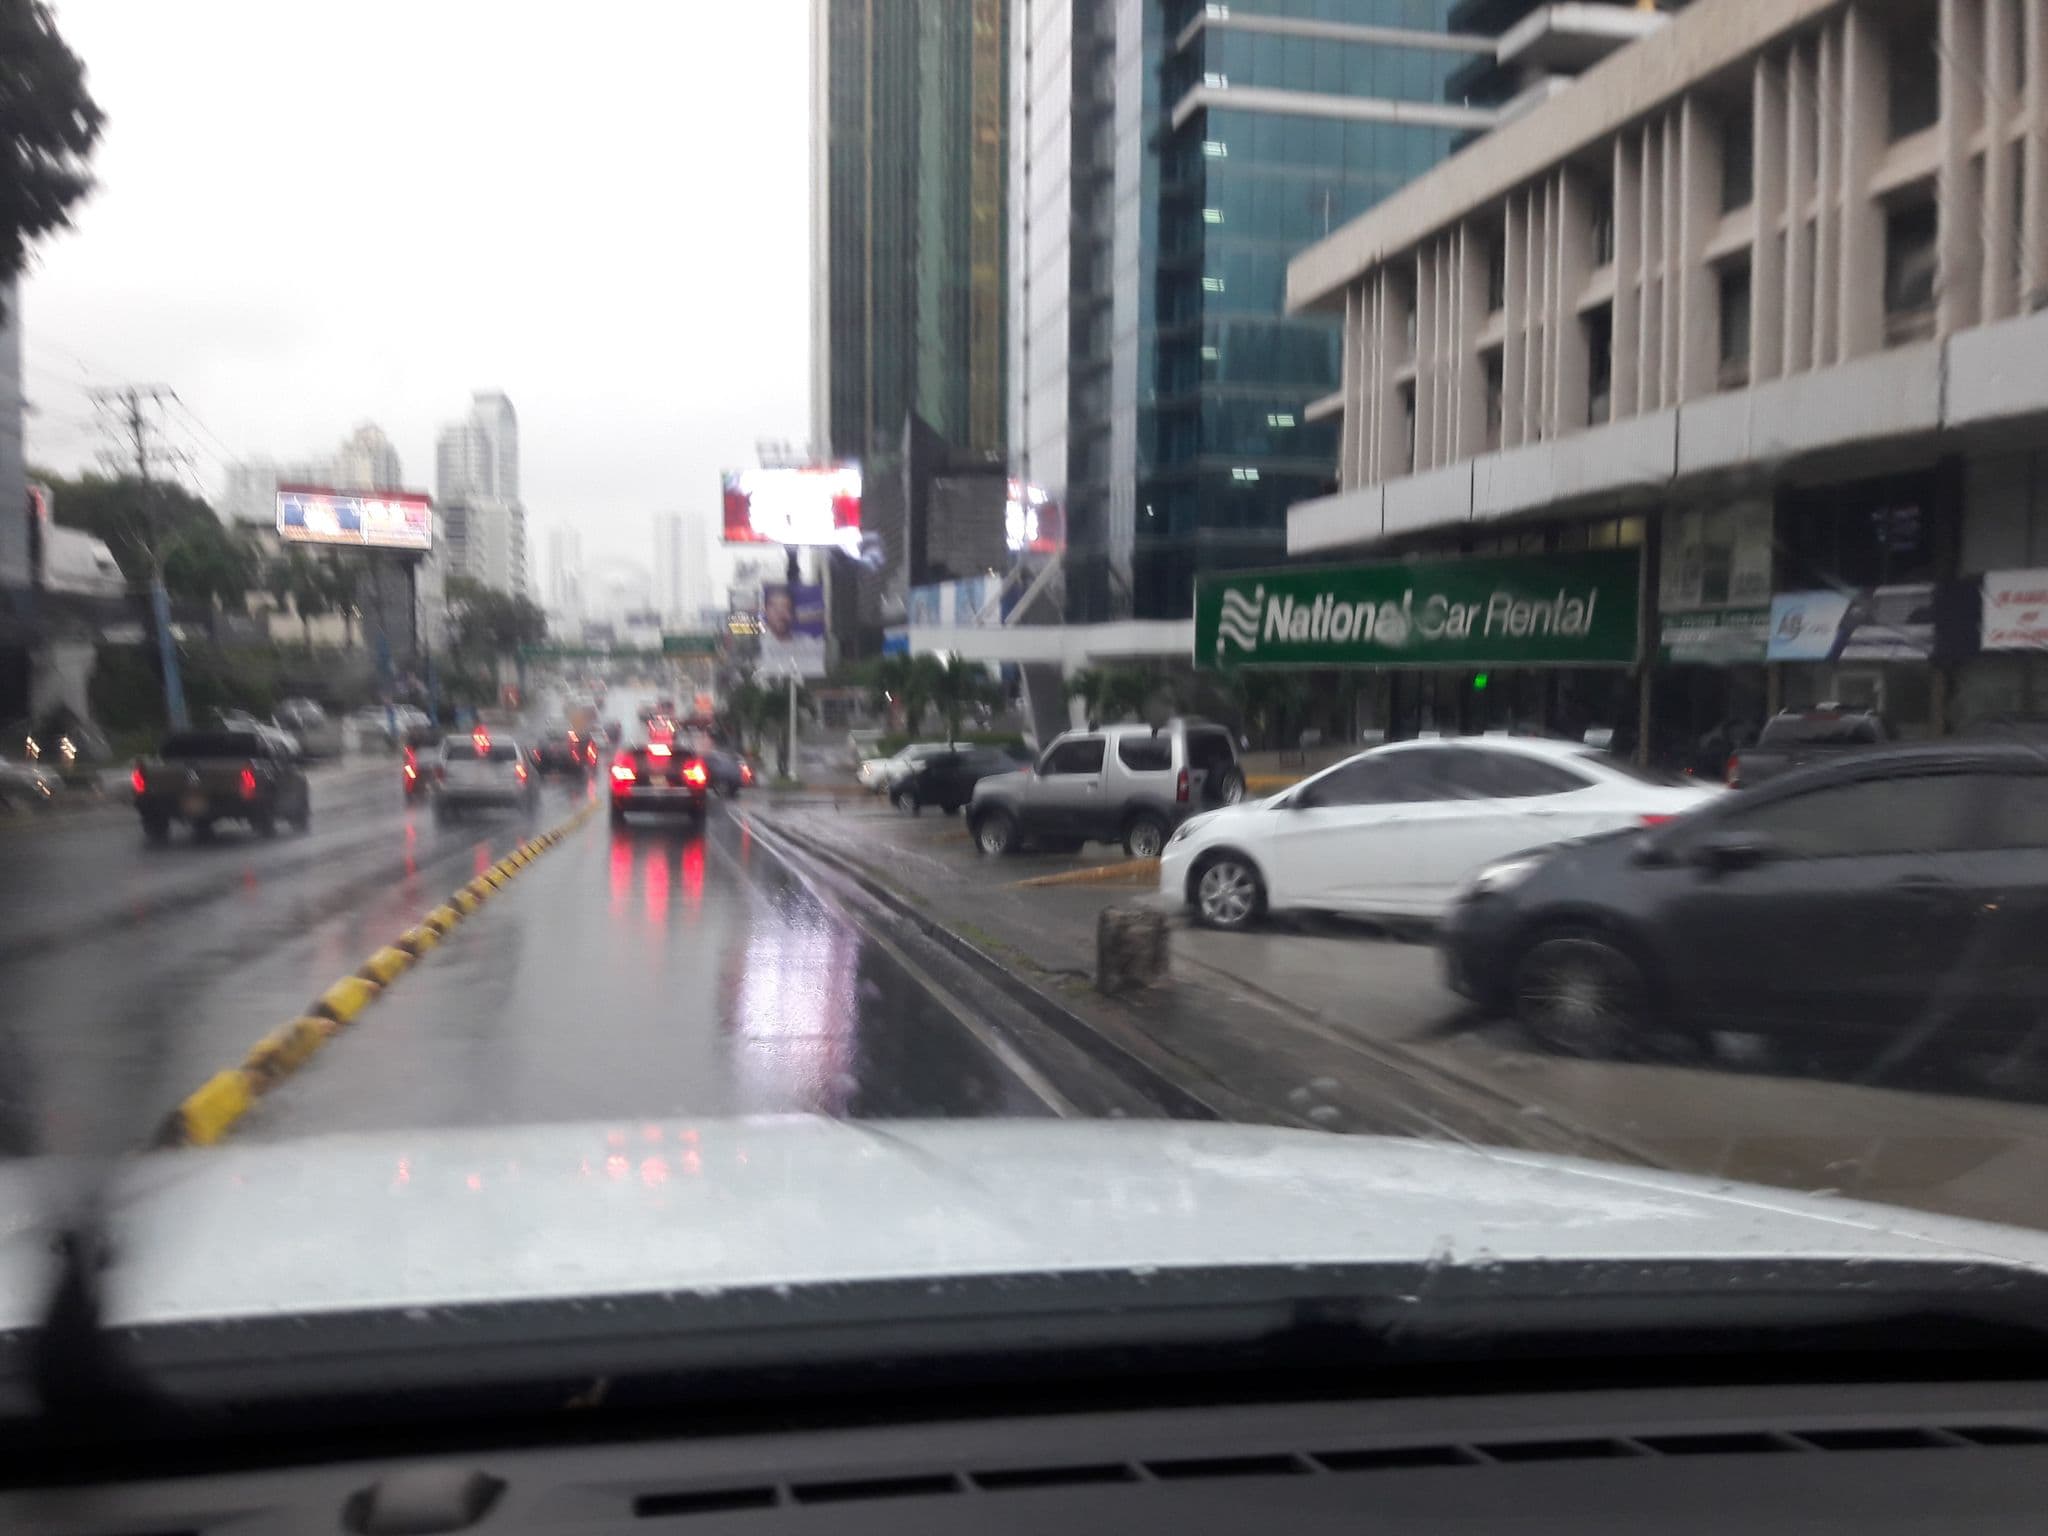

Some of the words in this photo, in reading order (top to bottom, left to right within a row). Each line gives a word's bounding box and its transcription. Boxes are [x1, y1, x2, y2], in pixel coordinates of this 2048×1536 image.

[1263, 588, 1412, 643] National
[1417, 594, 1482, 637] Car
[1484, 587, 1598, 638] Rental
